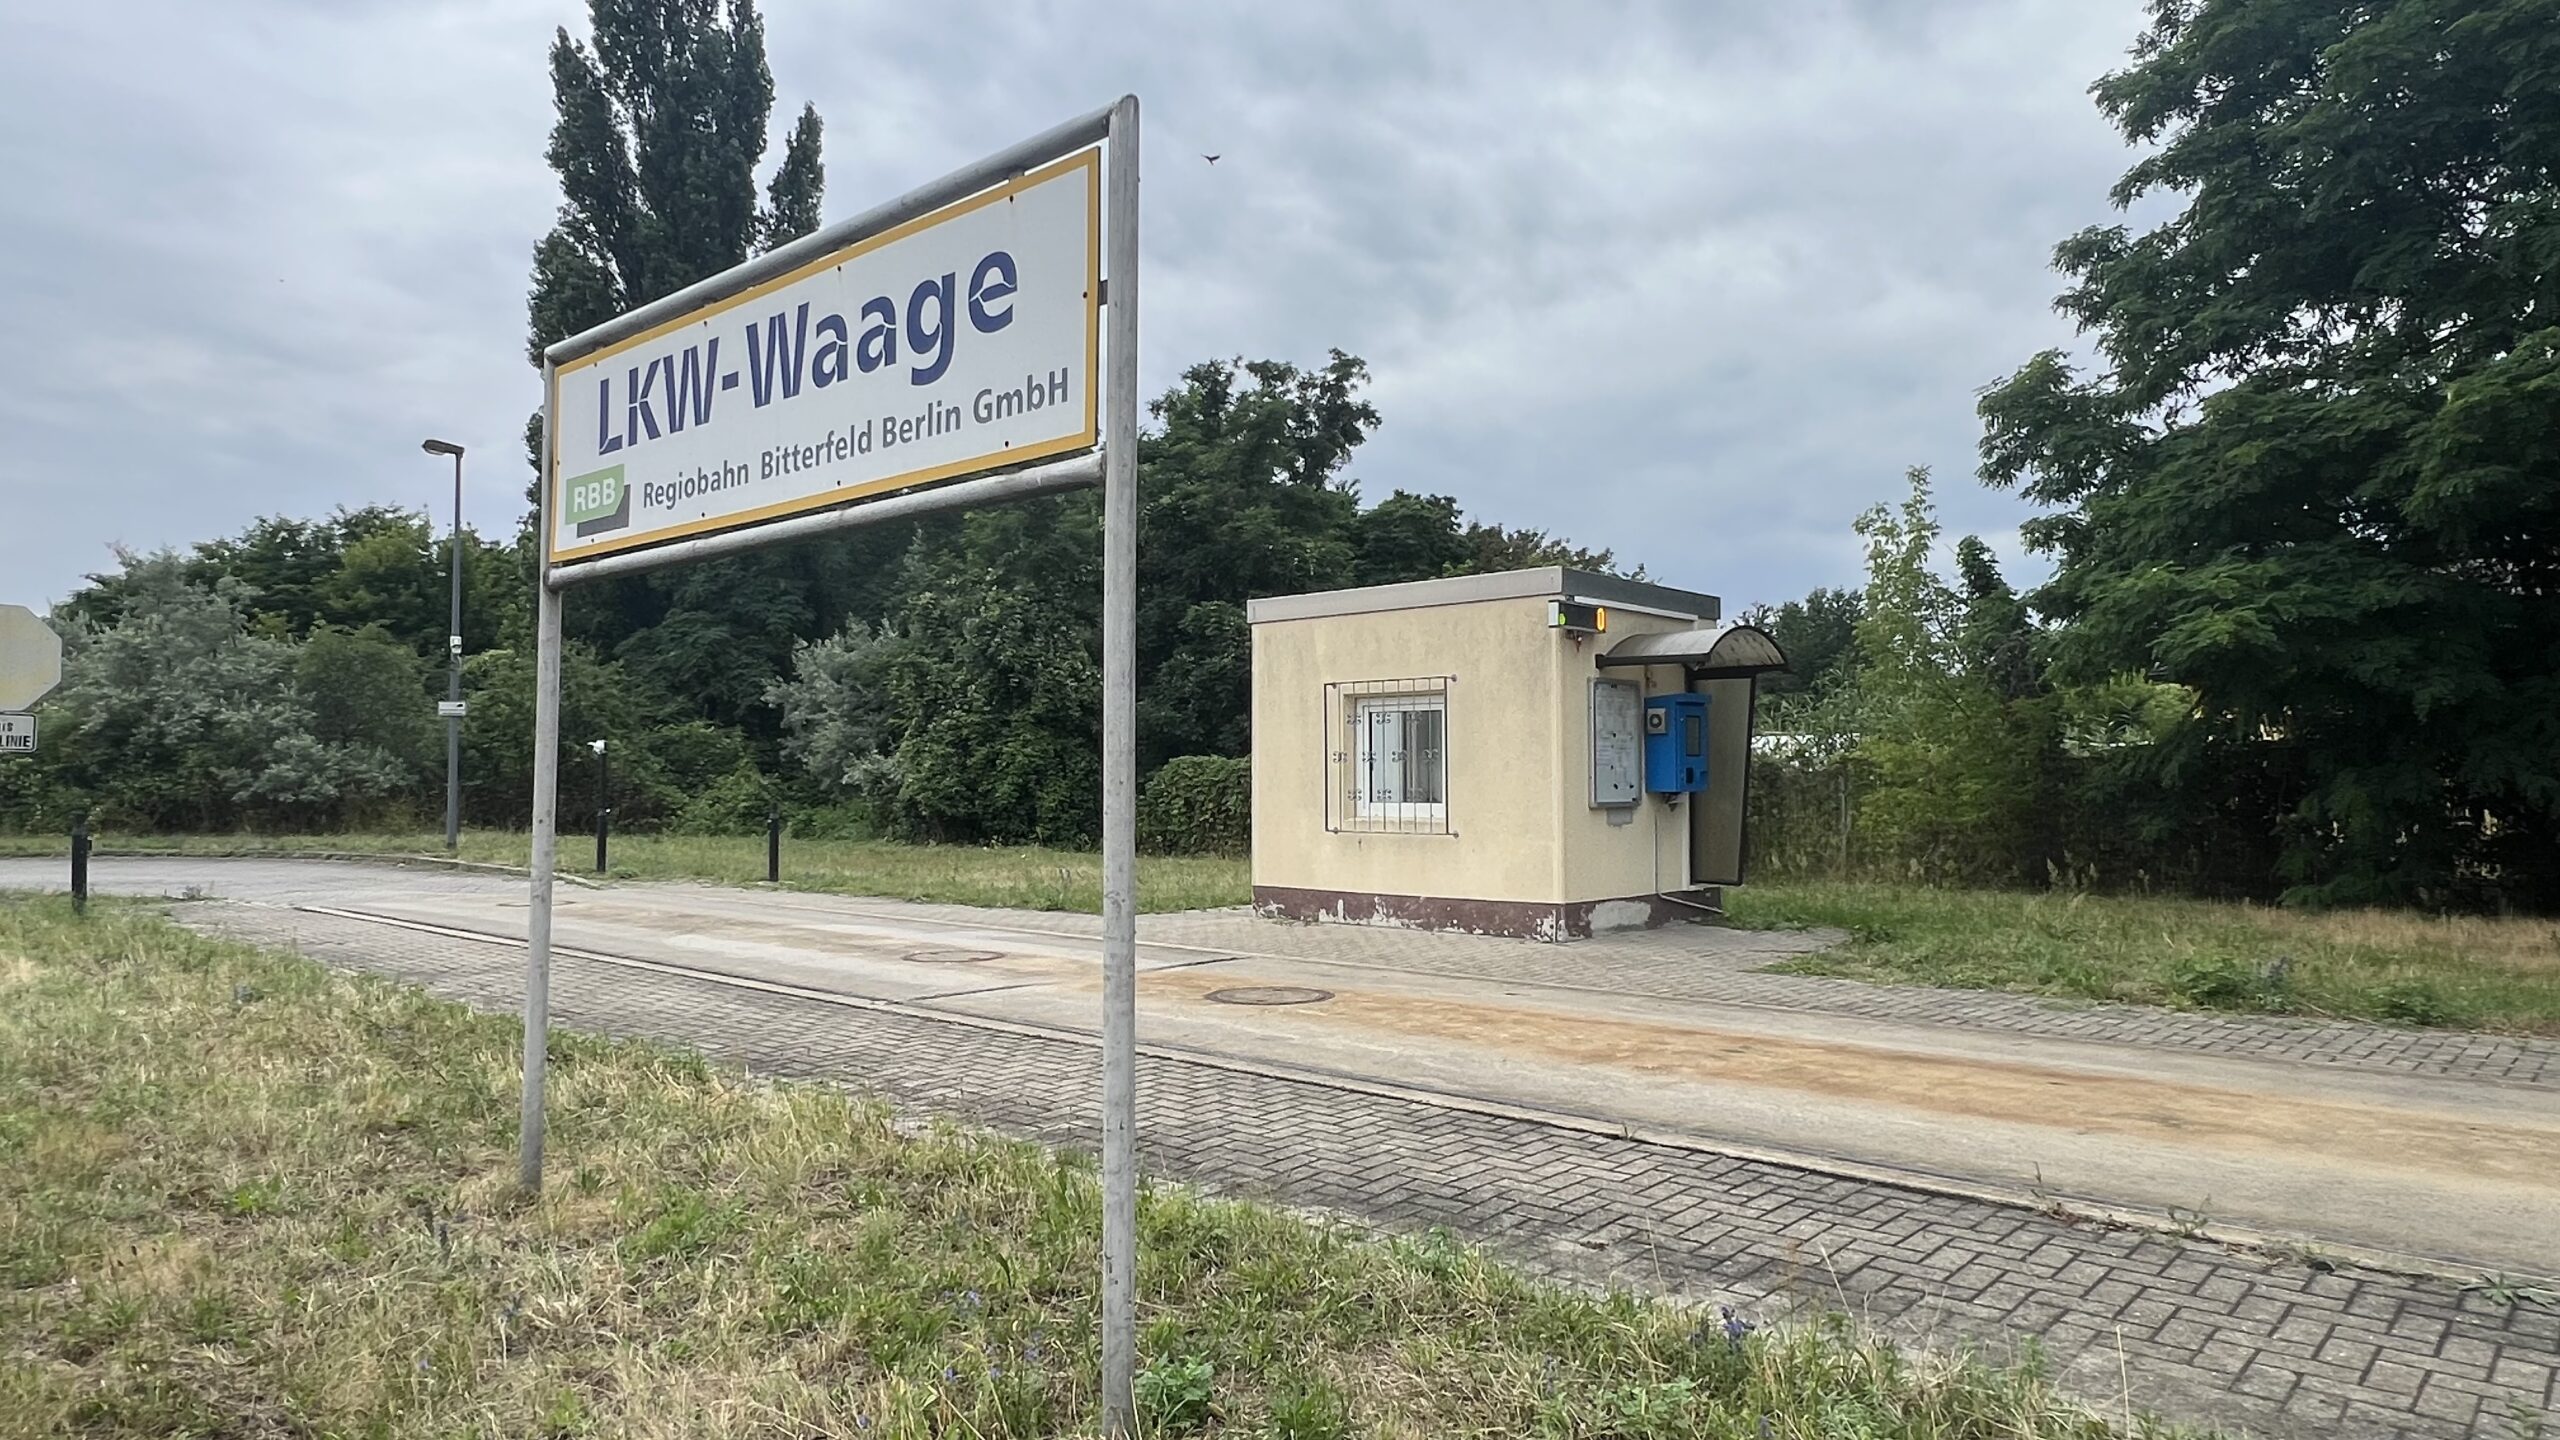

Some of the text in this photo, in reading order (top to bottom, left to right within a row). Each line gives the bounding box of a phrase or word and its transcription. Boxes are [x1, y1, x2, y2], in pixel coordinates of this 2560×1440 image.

[599, 252, 1018, 456] LKW-Waage
[573, 478, 616, 514] RBB
[643, 367, 1068, 509] Regiobahn Bitterfeld Berlin GmbH
